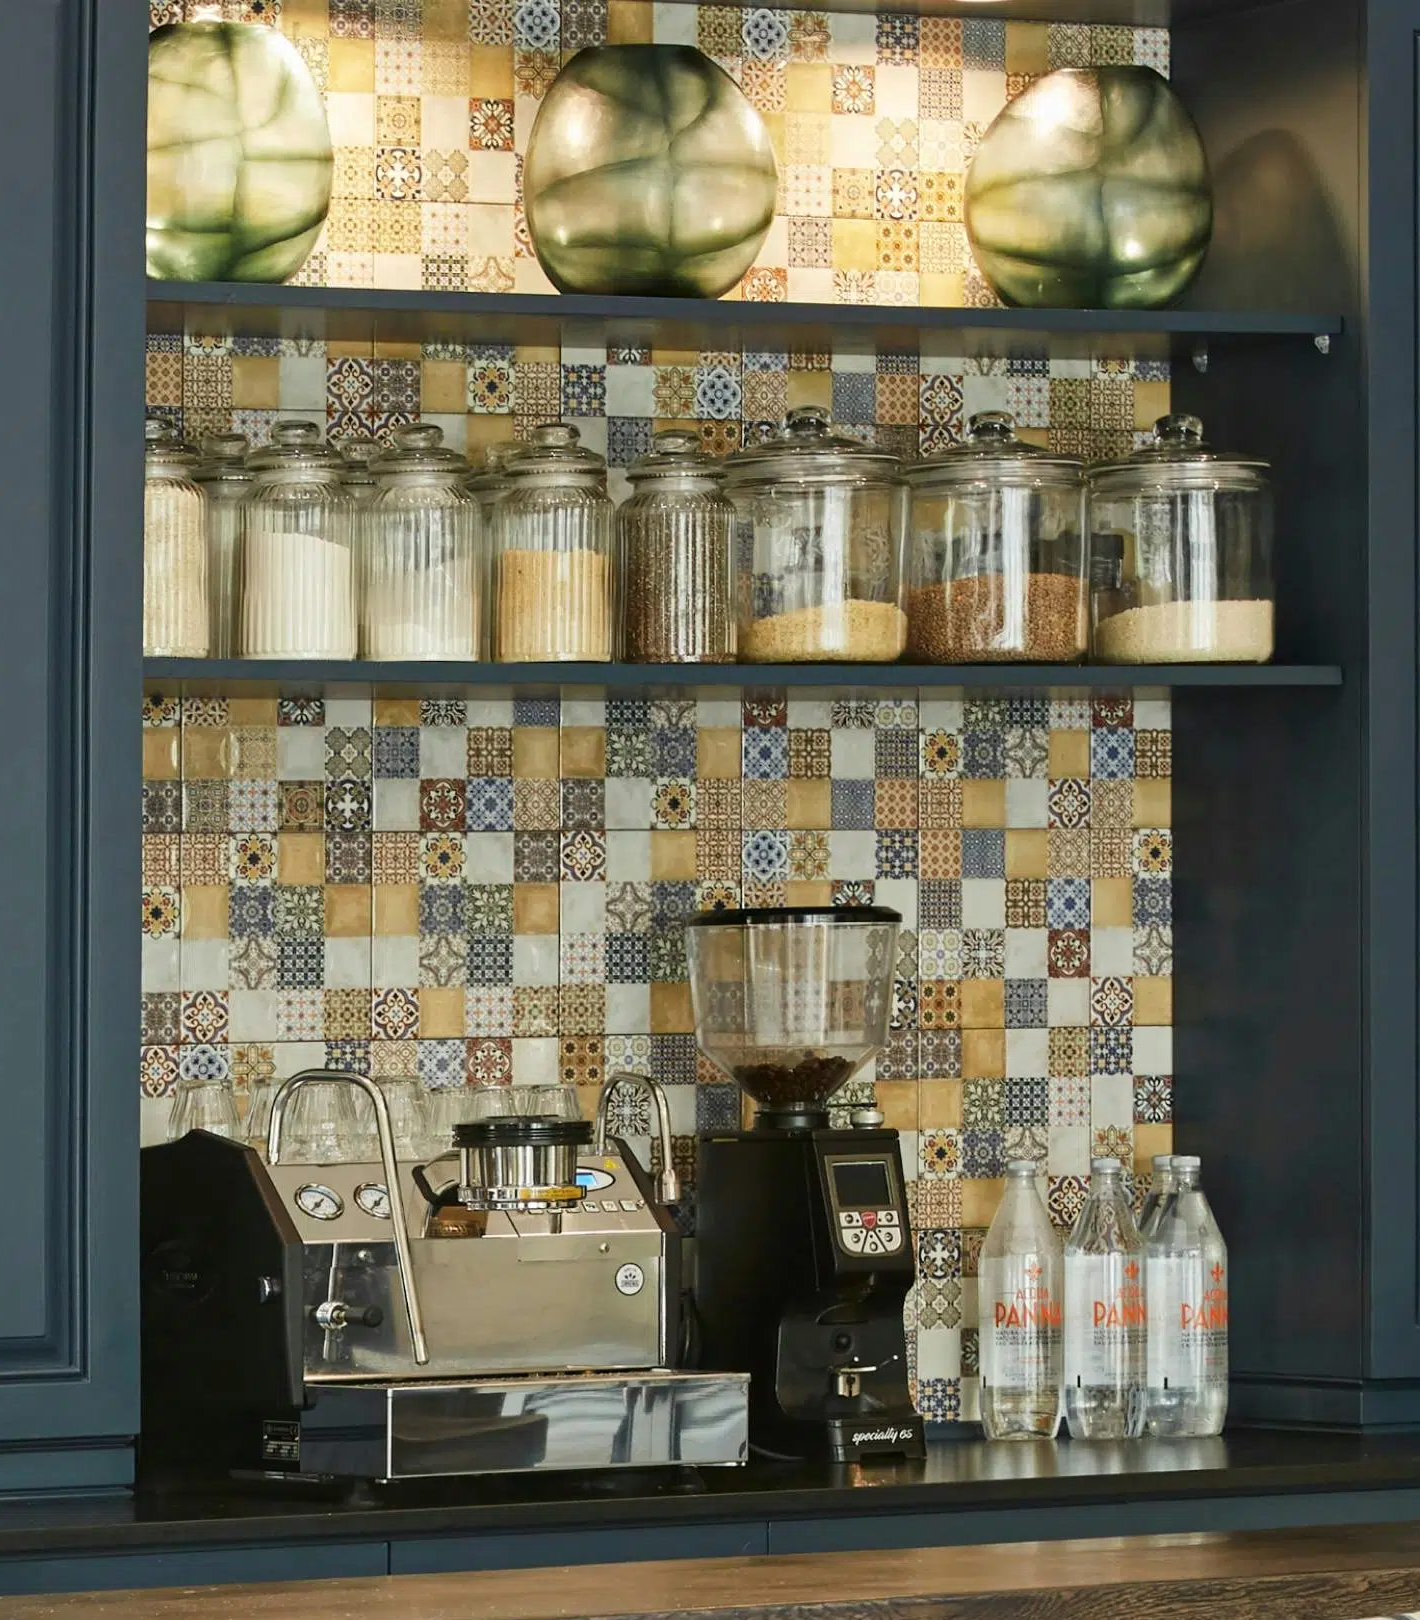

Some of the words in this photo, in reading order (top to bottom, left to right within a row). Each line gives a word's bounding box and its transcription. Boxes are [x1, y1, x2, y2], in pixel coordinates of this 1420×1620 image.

[996, 1302, 1062, 1328] PANNA
[852, 1427, 898, 1446] specialty
[899, 1428, 914, 1440] 65
